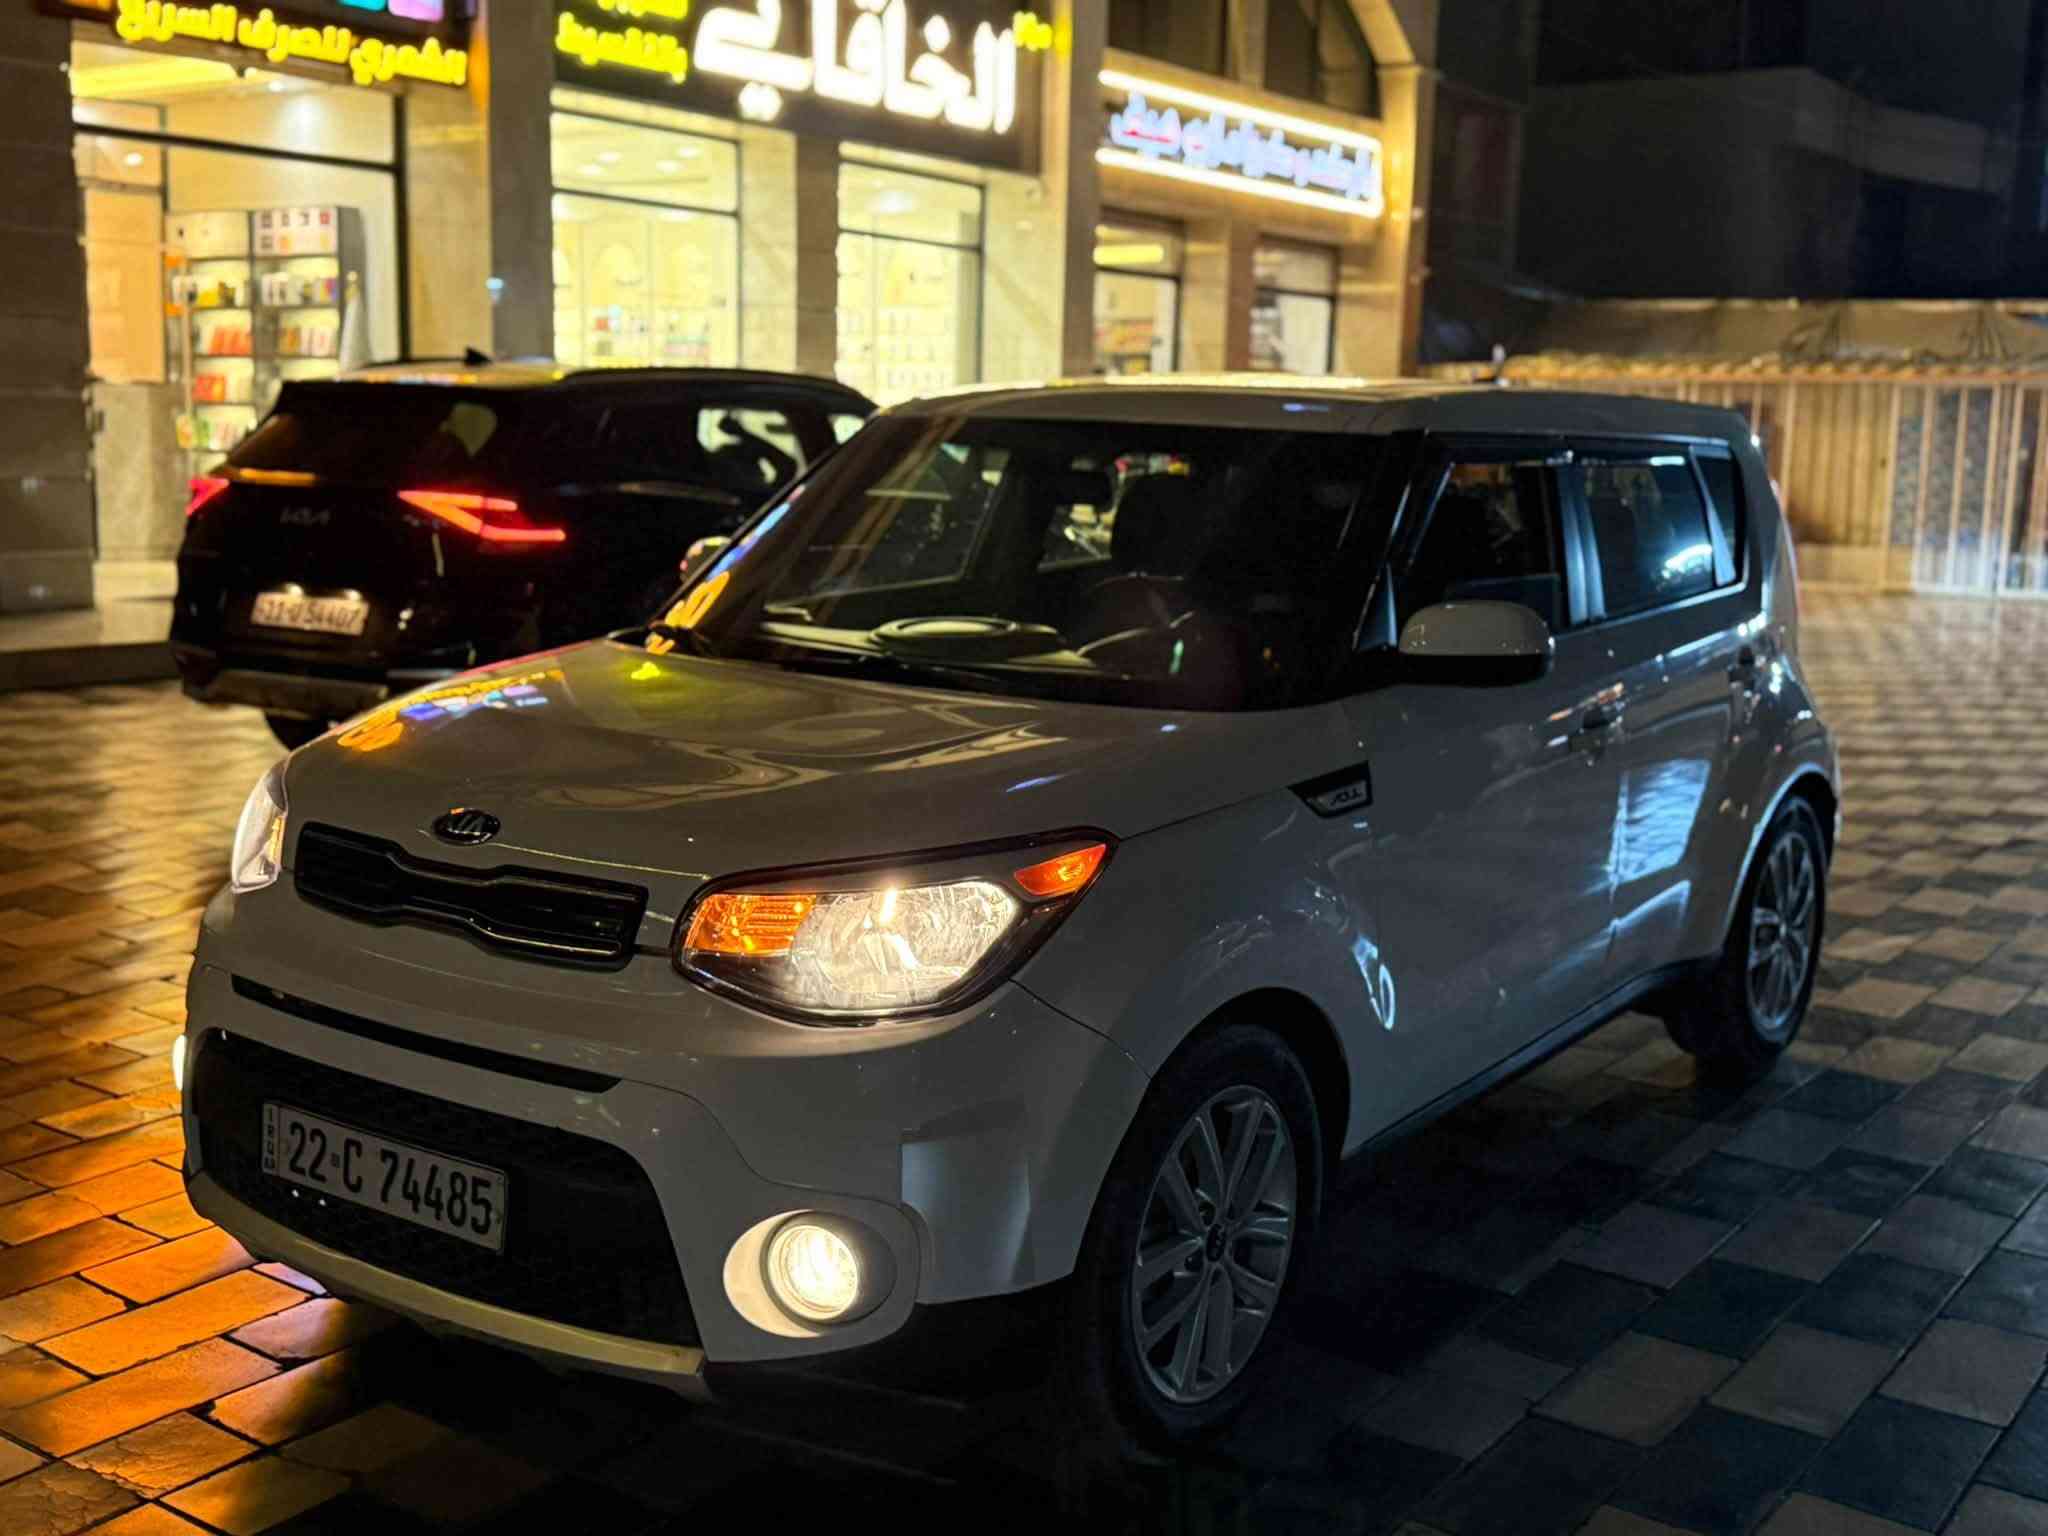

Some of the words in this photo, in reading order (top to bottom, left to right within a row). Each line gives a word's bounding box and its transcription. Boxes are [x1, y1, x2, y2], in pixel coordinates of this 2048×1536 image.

[289, 1121, 327, 1184] 22
[343, 1136, 363, 1194] C
[380, 1148, 493, 1236] 74485
